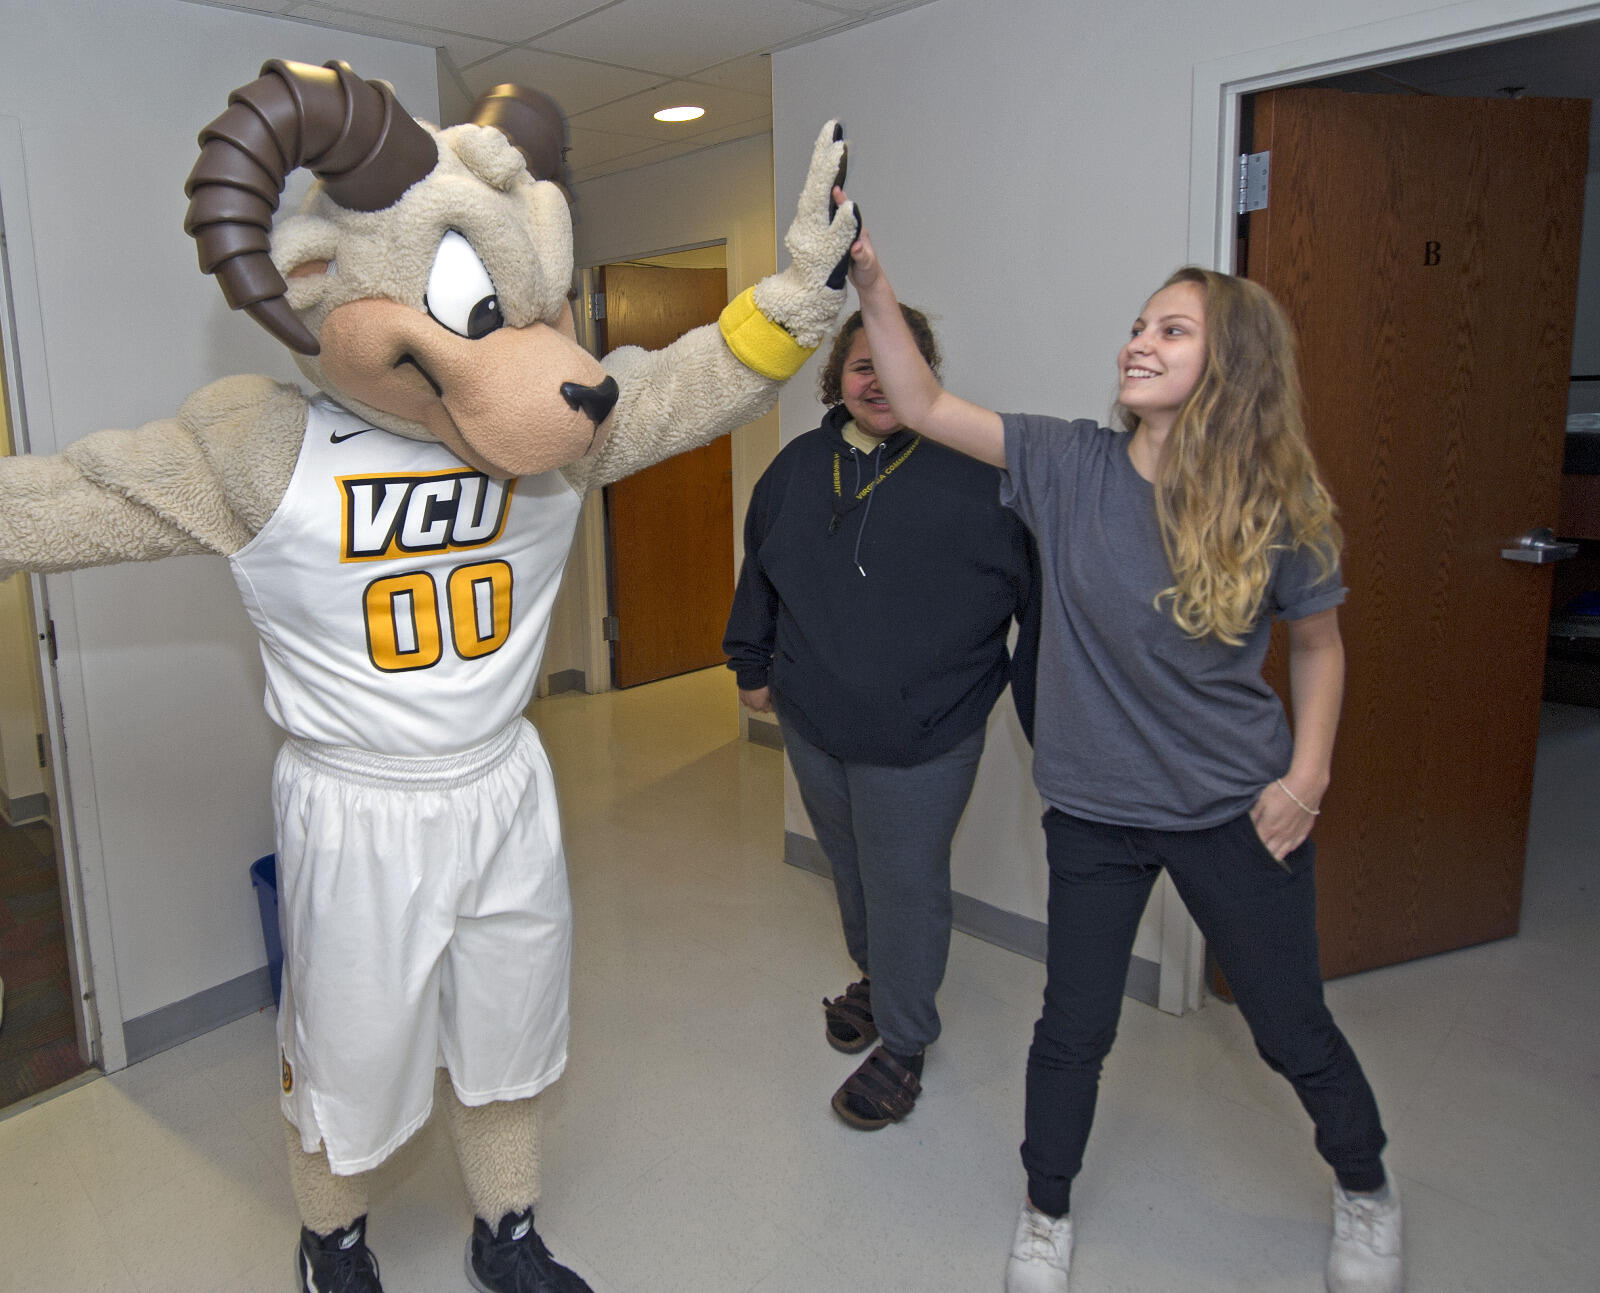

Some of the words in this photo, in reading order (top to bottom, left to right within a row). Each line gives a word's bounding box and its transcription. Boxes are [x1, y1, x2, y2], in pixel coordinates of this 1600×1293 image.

[1424, 241, 1441, 266] B
[343, 473, 511, 559] VCU
[362, 559, 513, 673] 00
